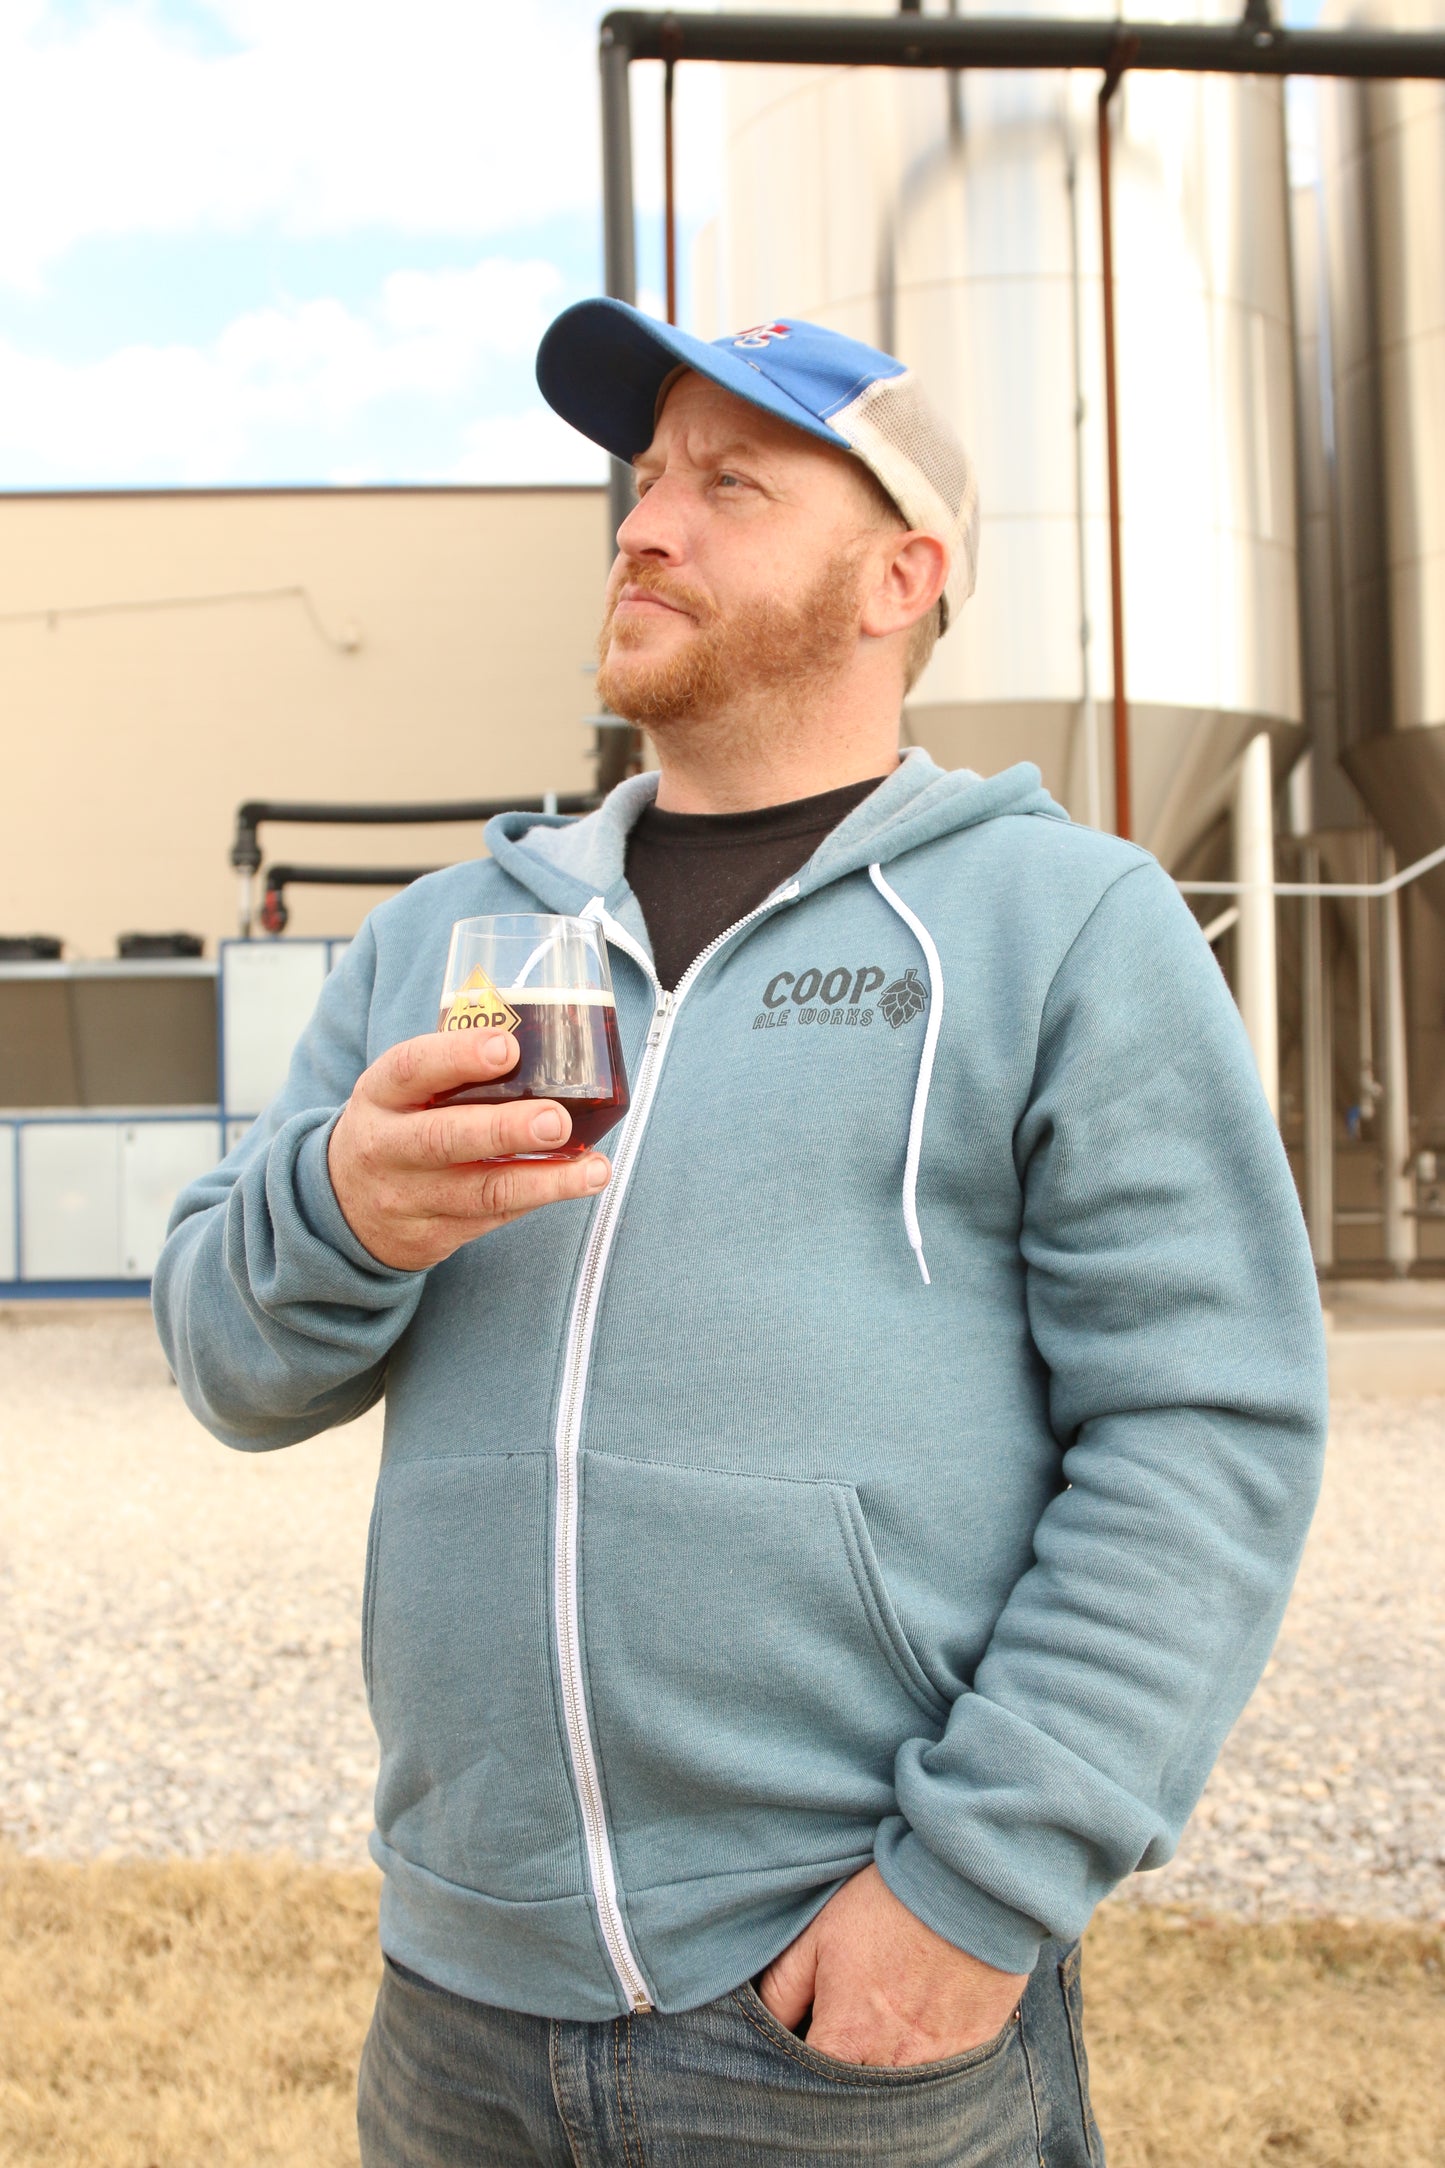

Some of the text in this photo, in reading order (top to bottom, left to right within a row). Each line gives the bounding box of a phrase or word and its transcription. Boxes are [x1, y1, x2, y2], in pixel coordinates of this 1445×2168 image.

[762, 966, 886, 1009] COOP
[447, 1012, 507, 1032] COOP
[752, 1008, 874, 1030] ALE WORKS
